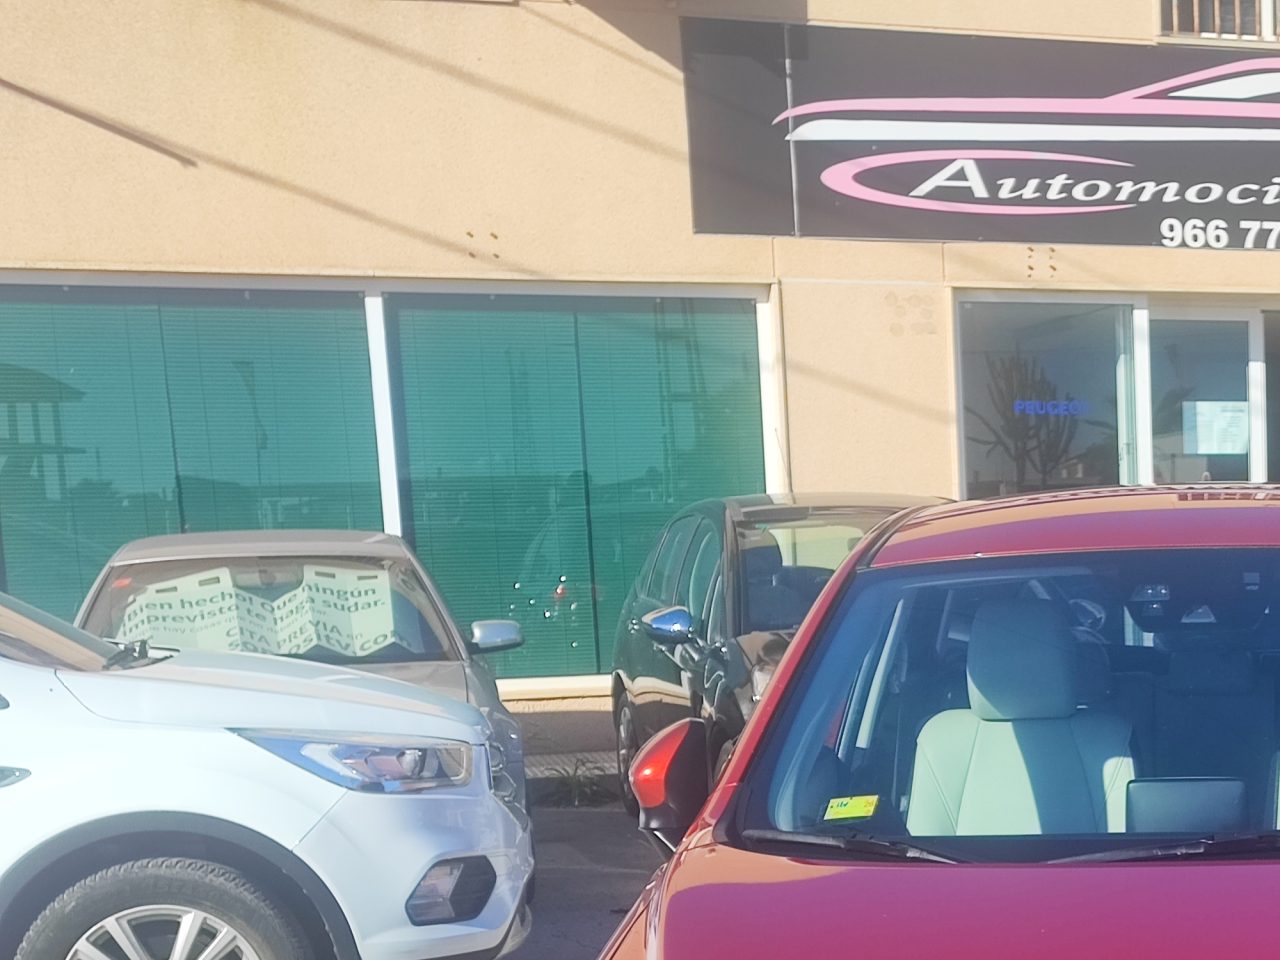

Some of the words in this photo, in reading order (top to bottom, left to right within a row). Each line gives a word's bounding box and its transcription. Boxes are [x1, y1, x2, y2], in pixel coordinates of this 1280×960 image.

[1159, 217, 1230, 249] 966
[1013, 400, 1090, 416] PEUGEO
[225, 624, 272, 648] CITA
[276, 619, 343, 650] PREVIA
